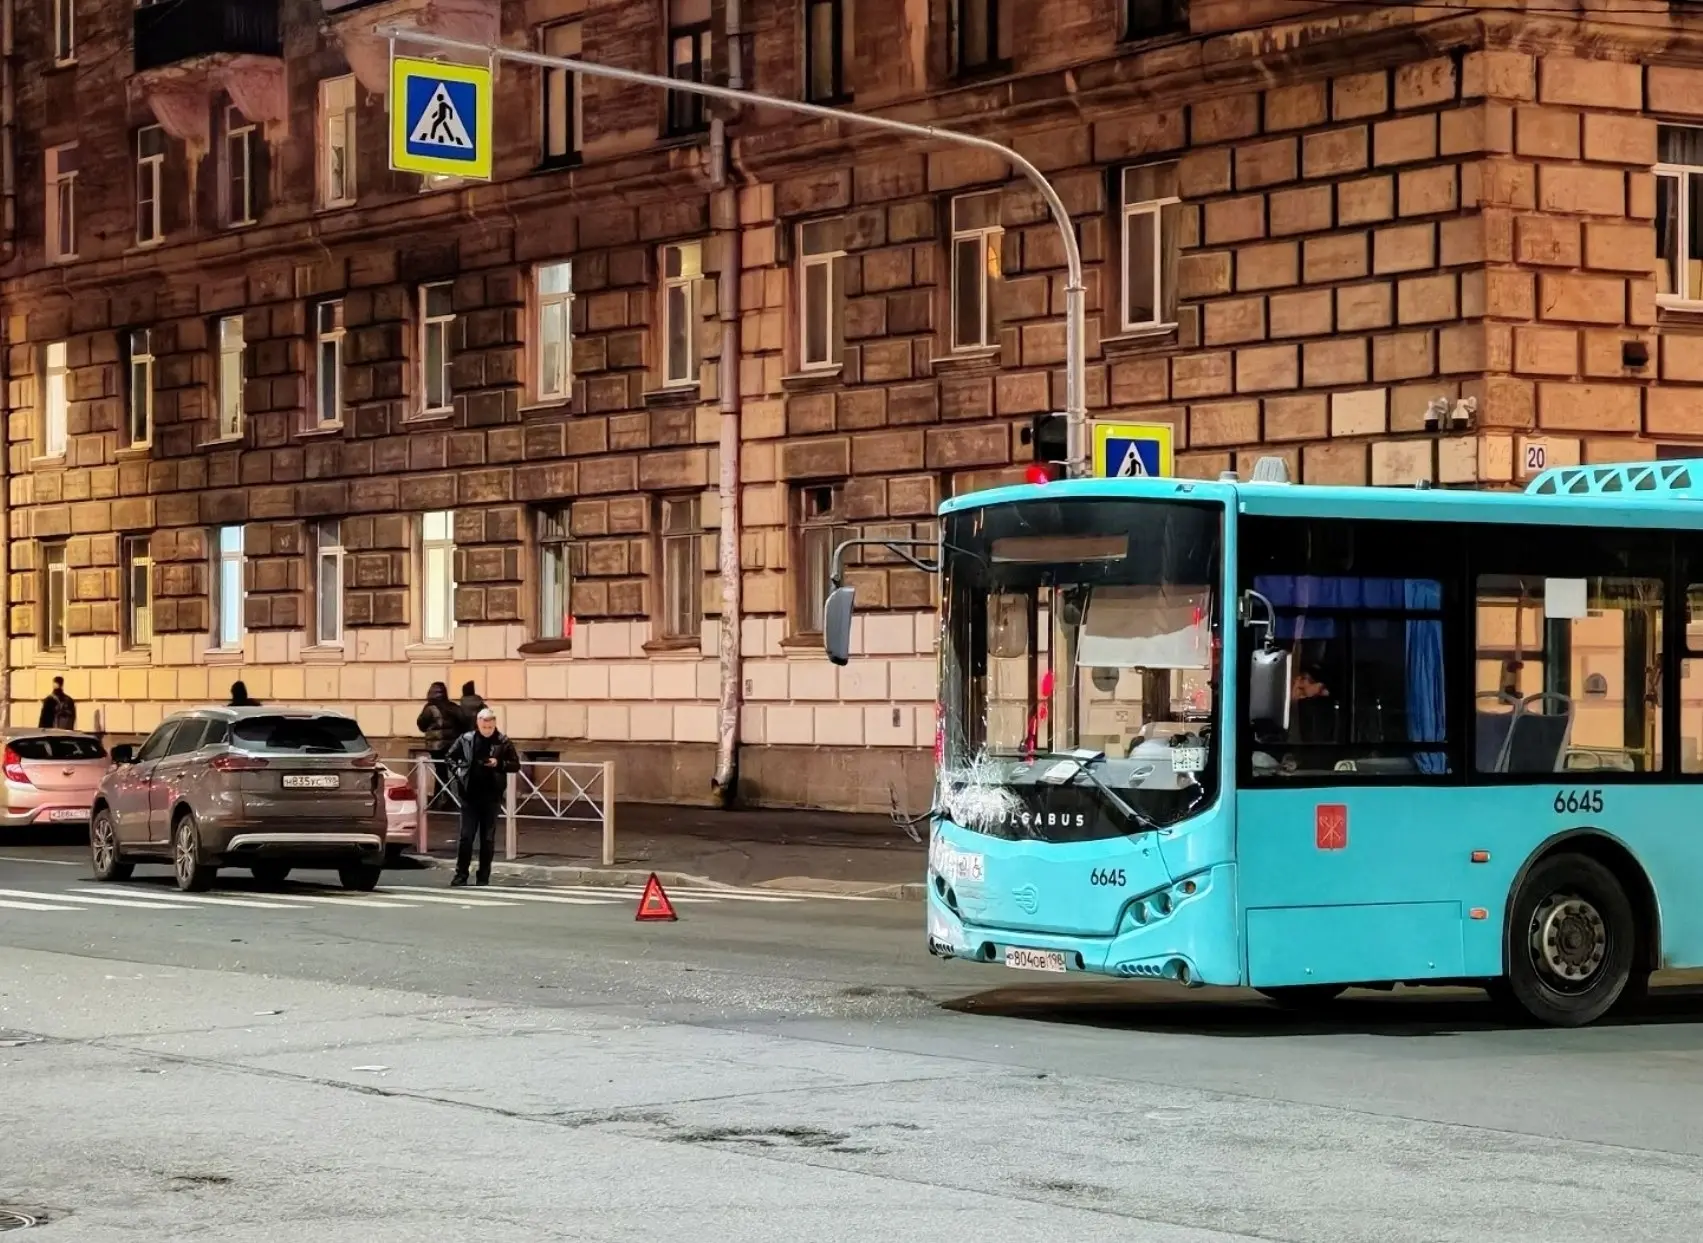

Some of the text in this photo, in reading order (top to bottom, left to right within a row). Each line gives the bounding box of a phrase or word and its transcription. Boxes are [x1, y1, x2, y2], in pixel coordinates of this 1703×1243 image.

[1528, 447, 1545, 469] 20
[1553, 789, 1604, 814] 6645
[1090, 867, 1127, 887] 6645
